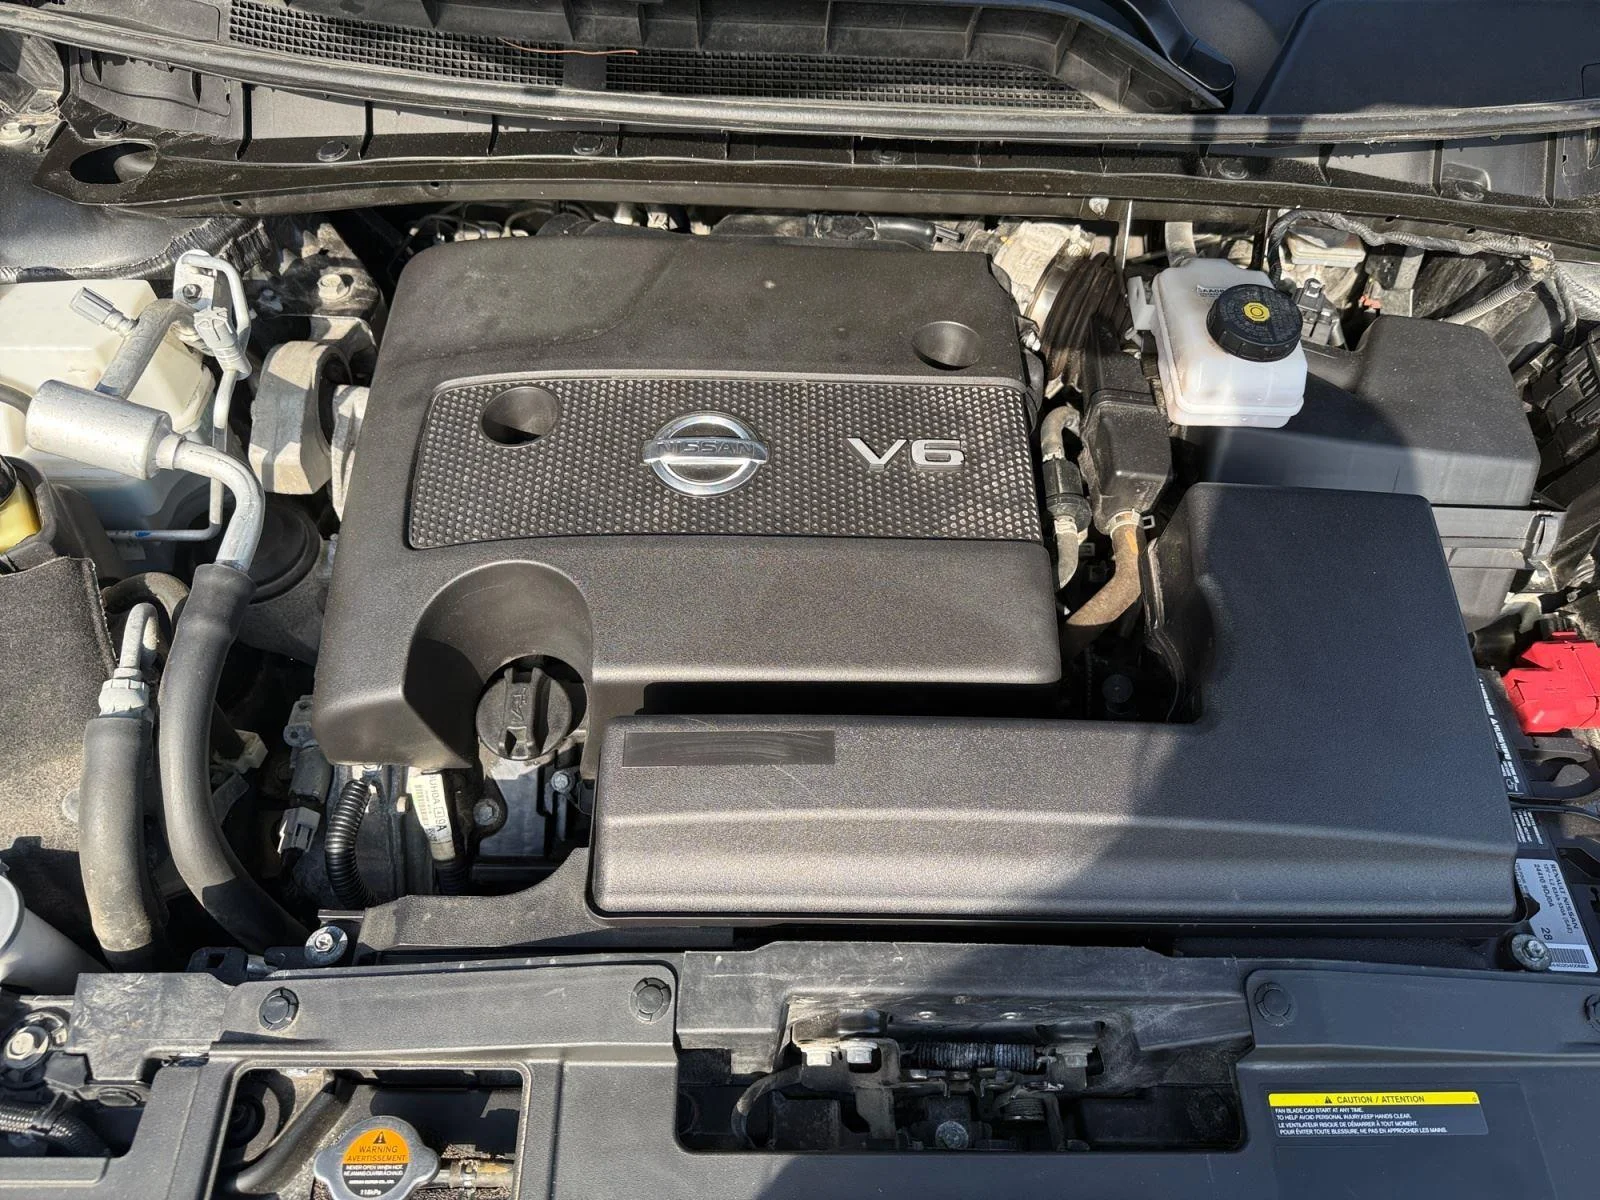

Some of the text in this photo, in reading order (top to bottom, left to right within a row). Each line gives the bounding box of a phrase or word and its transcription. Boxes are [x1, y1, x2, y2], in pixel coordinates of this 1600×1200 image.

[656, 440, 755, 455] NISSAN
[847, 437, 966, 471] V6
[1534, 864, 1546, 883] 24410
[1562, 897, 1579, 929] NISSAN
[1541, 927, 1553, 940] 28
[1337, 1095, 1373, 1104] CAUTION
[1382, 1095, 1425, 1104] ATTENTION
[1296, 1127, 1314, 1135] ÉVITER
[359, 1145, 398, 1153] WARNING
